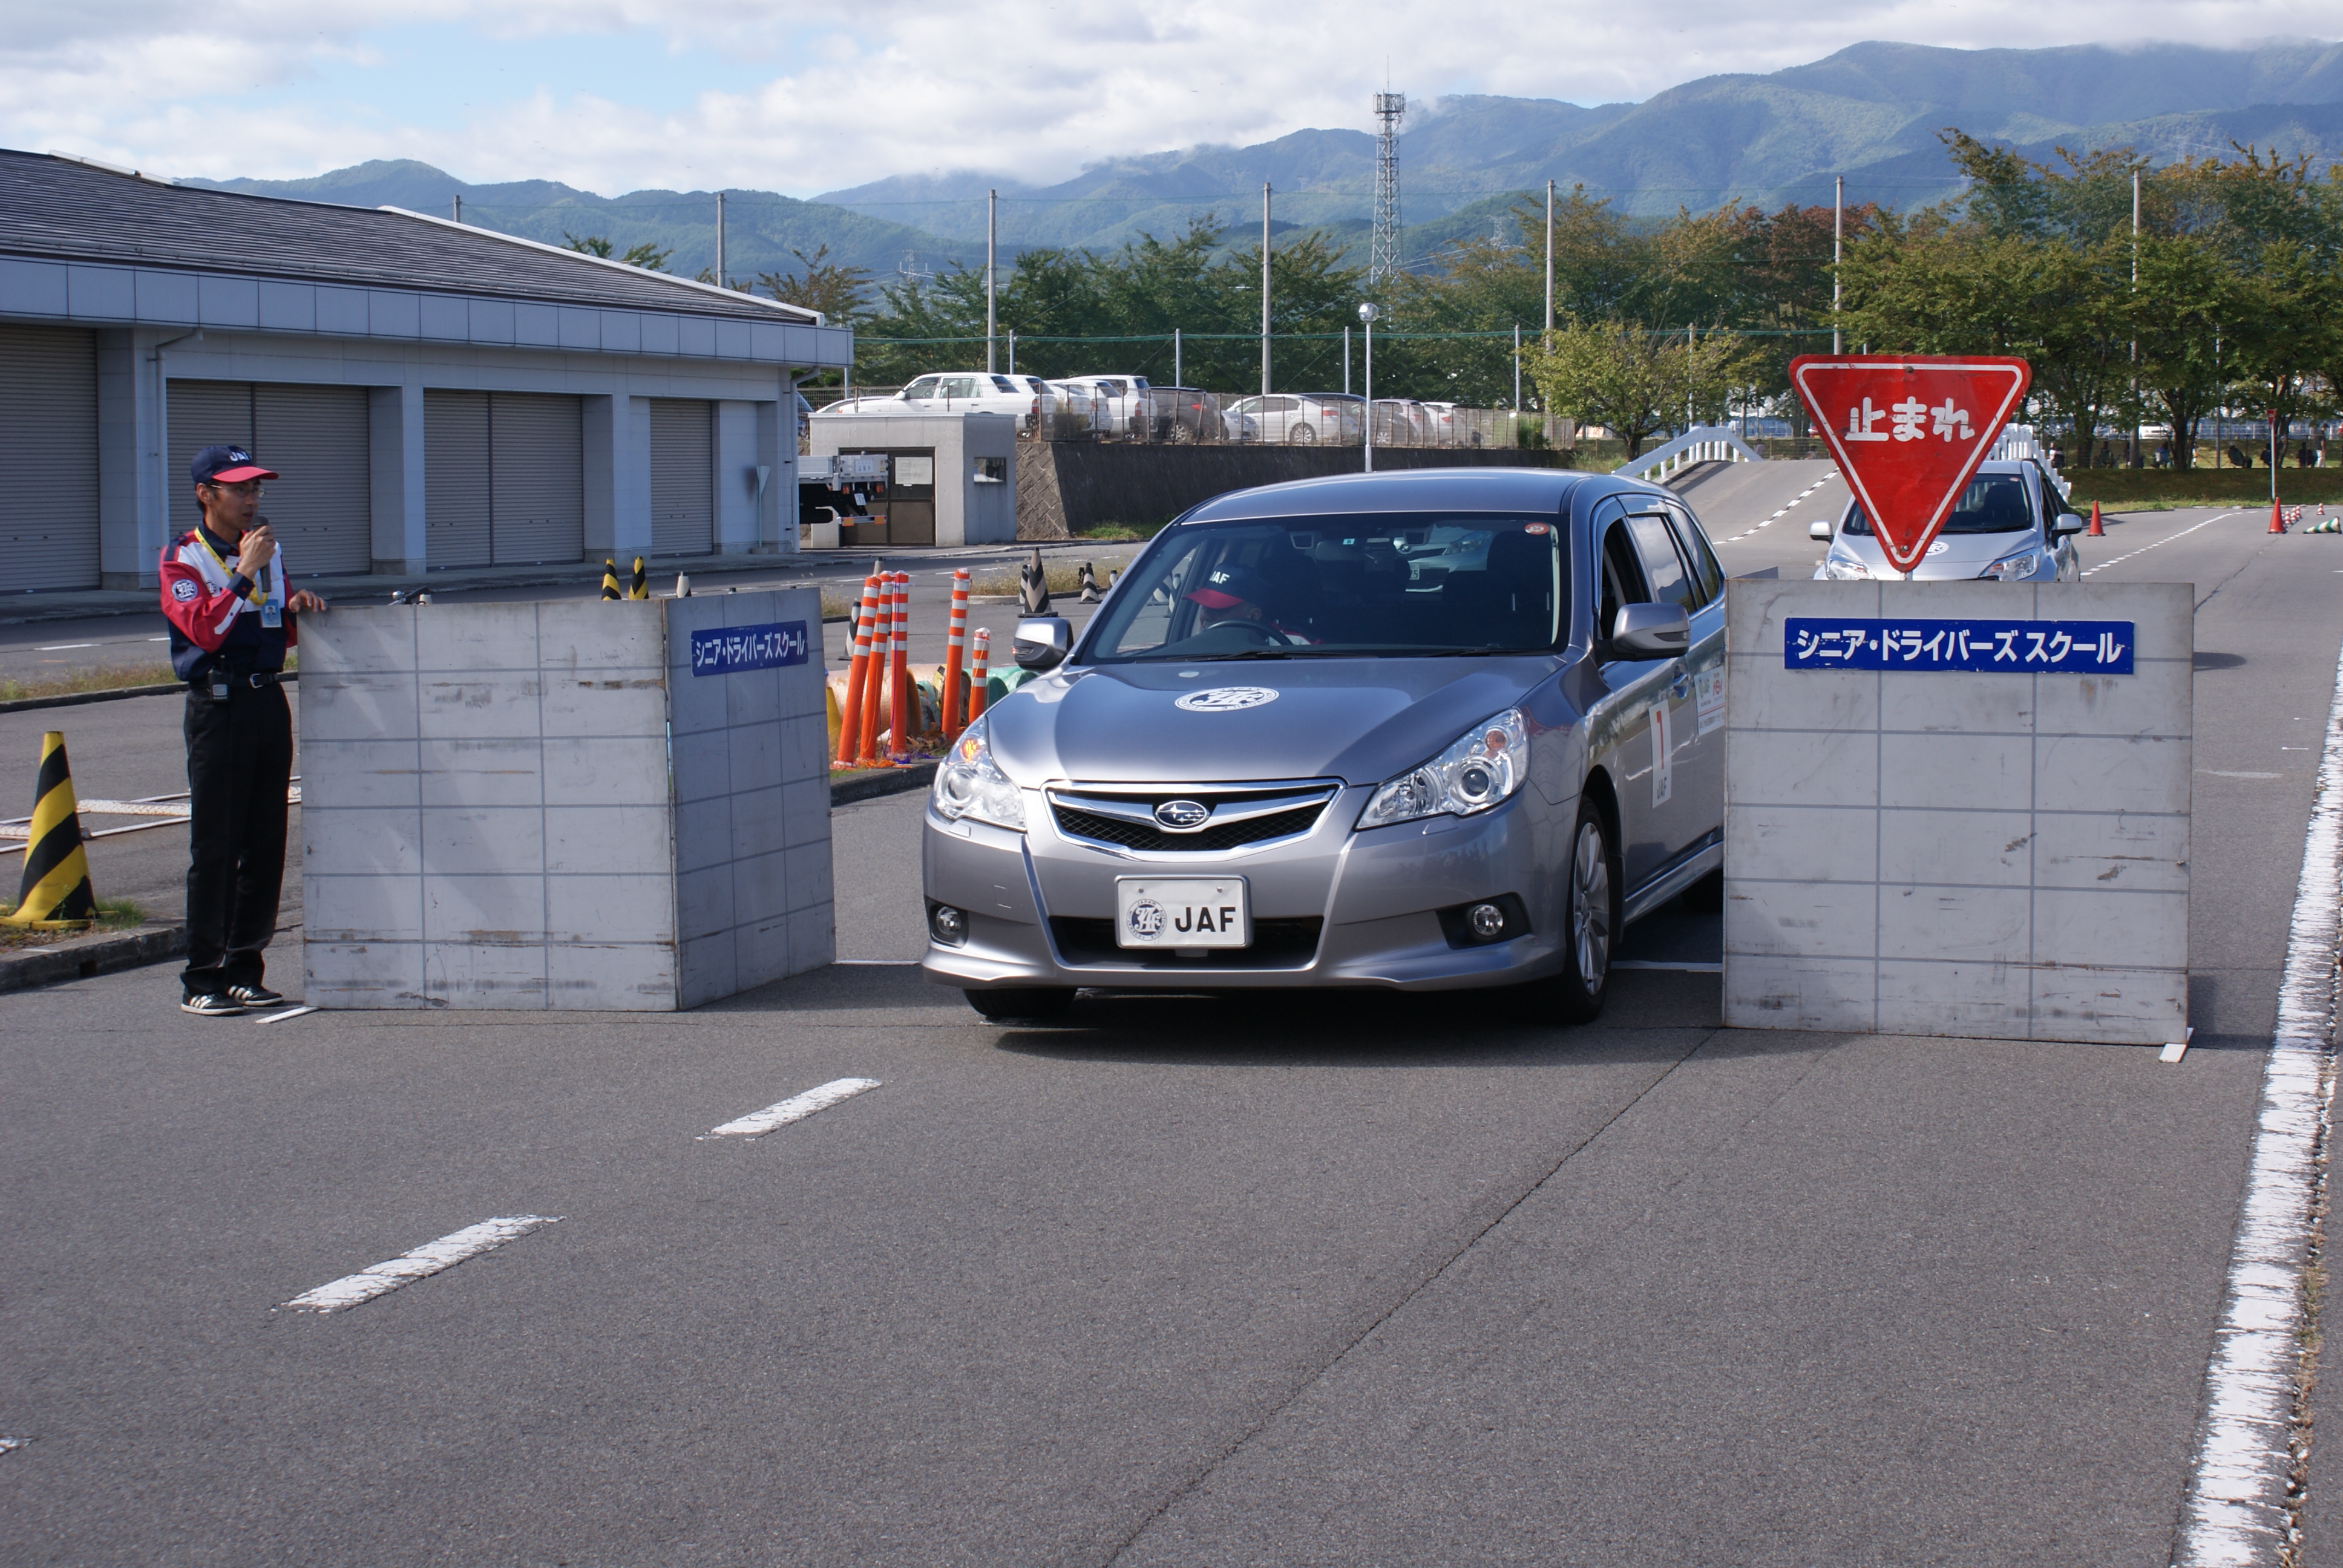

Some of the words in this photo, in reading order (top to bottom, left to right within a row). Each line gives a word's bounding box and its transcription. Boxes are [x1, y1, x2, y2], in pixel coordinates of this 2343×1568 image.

[1844, 396, 1974, 443] 止まれ
[1175, 906, 1236, 933] JAF
